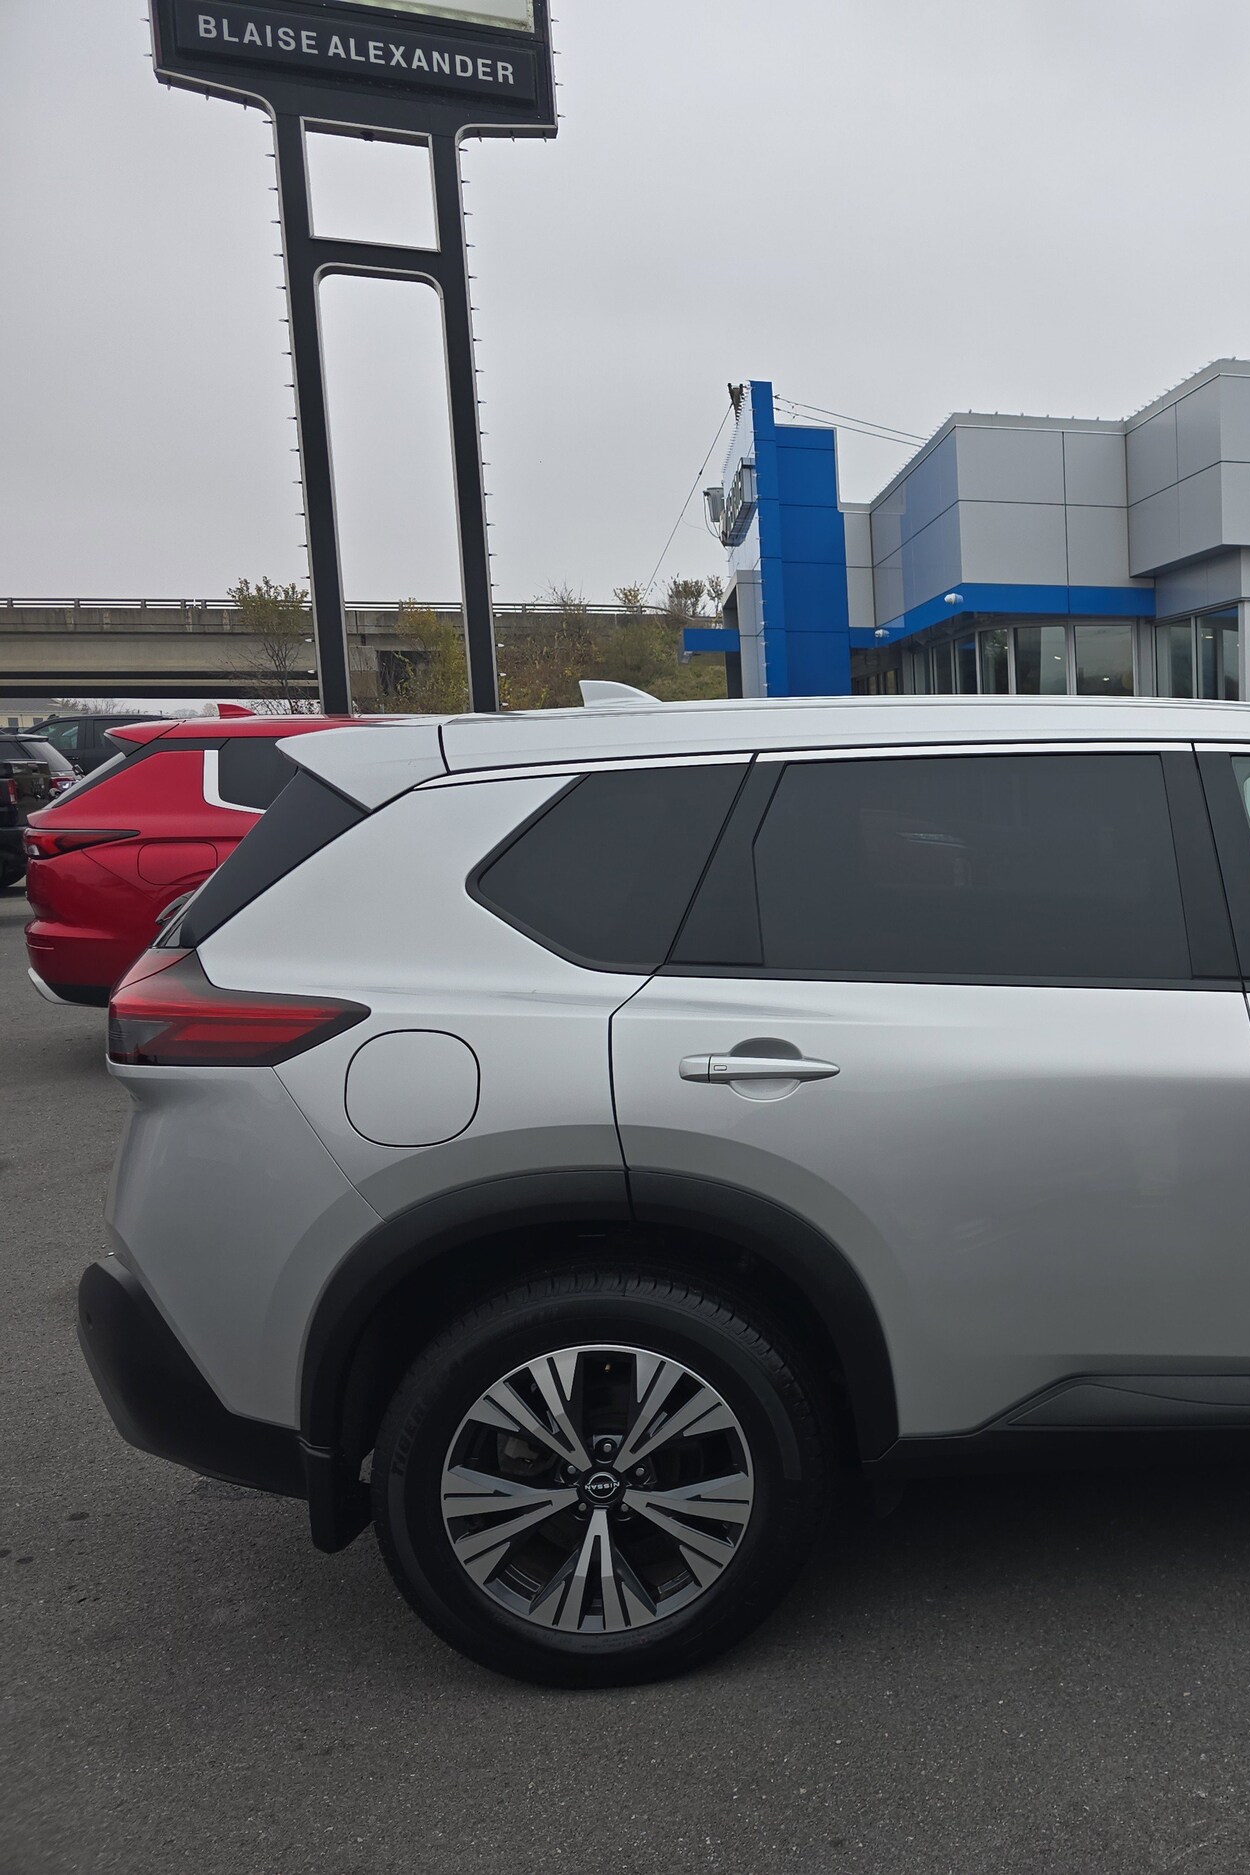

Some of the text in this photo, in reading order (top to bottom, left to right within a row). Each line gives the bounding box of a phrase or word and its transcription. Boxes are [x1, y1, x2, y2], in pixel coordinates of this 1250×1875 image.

[198, 15, 515, 85] BLAISE ALEXANDER
[584, 1482, 620, 1490] NISSAN
